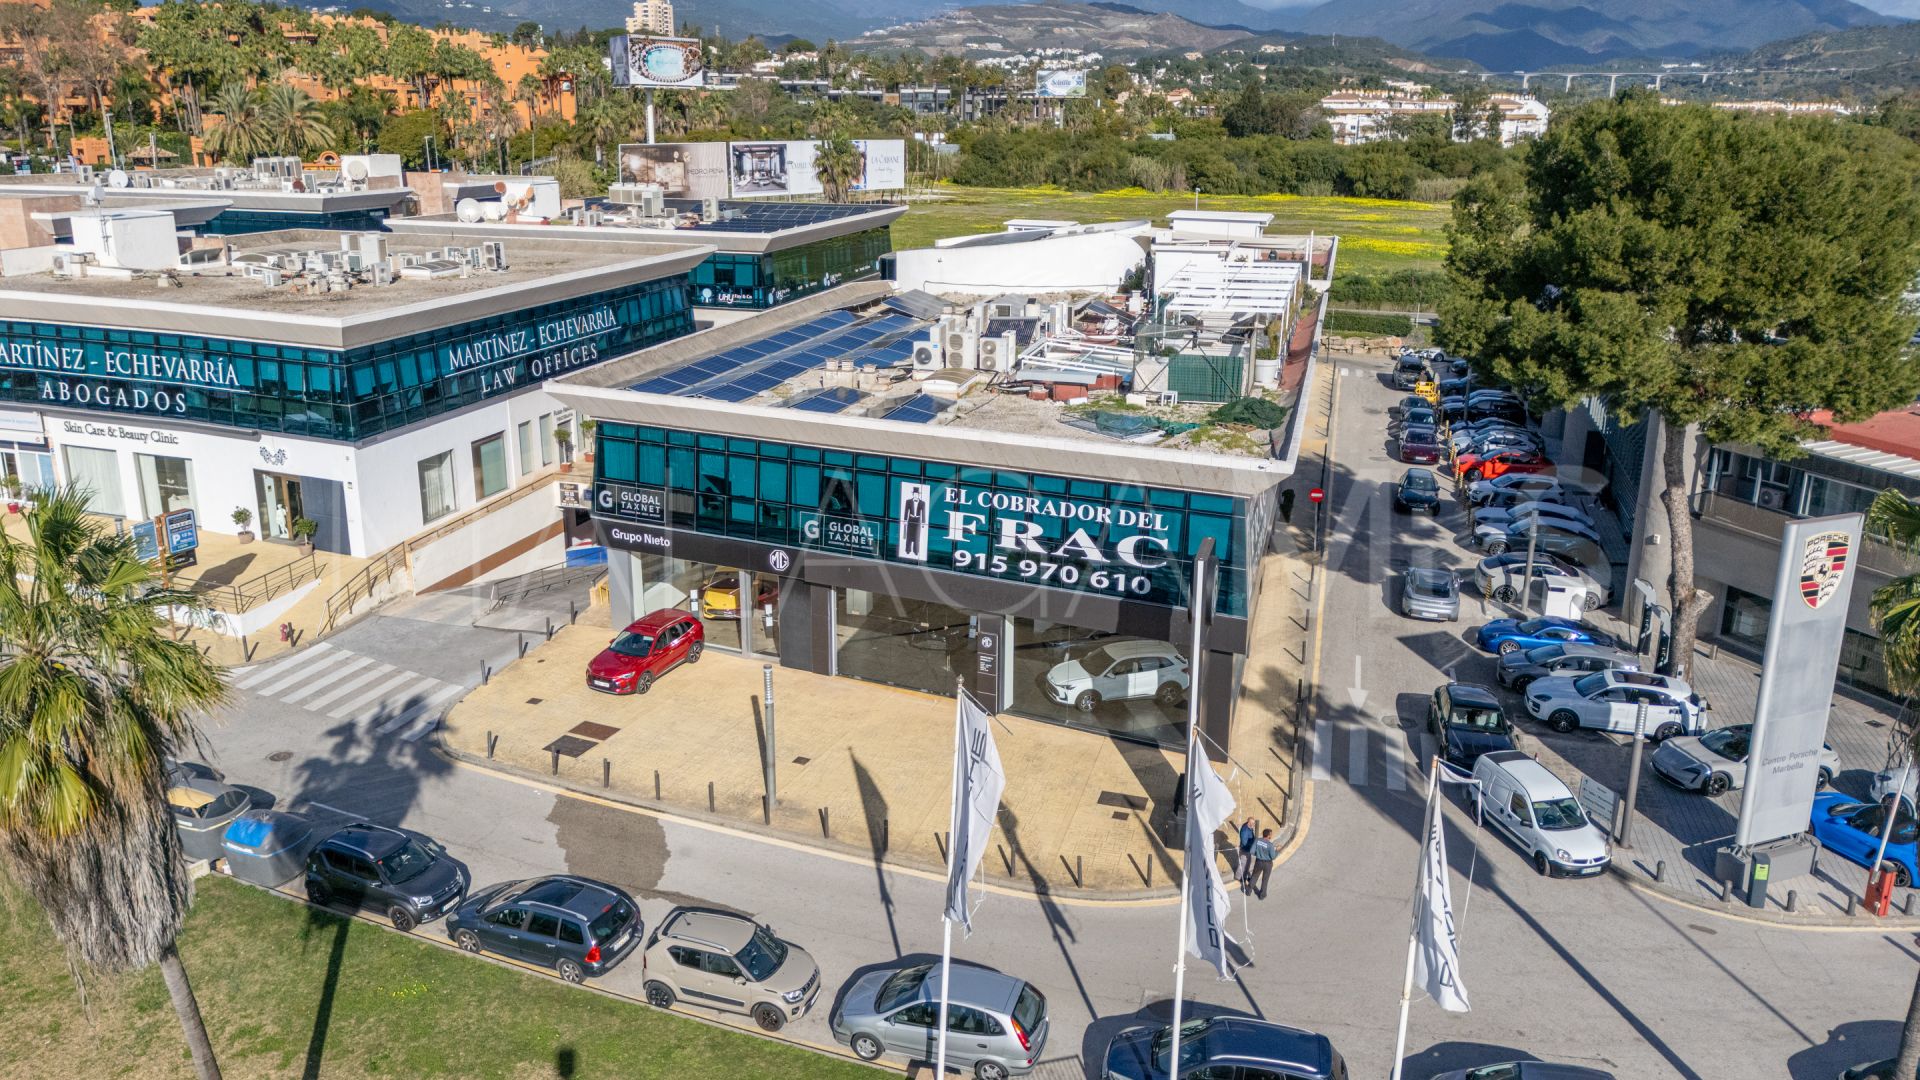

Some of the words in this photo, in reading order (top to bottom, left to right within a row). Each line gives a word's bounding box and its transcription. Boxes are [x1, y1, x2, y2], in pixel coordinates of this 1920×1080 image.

[449, 331, 528, 370] MARTÍNEZ
[539, 306, 617, 345] ECHEVARRÍA
[0, 340, 86, 371] ARTÍNEZ
[104, 350, 240, 386] ECHEVARRÍA
[480, 366, 517, 393] LAW
[41, 381, 186, 412] ABOGADOS
[63, 420, 83, 433] Skin
[84, 423, 106, 437] Care
[107, 426, 117, 438] &
[118, 427, 149, 444] Beauty
[150, 430, 179, 445] Clinic
[599, 490, 613, 508] G
[621, 491, 661, 505] GLOBAL
[621, 501, 661, 514] TAXNET
[944, 486, 973, 506] EL
[977, 491, 1112, 524] COBRADOR
[1117, 509, 1169, 532] DEL
[612, 528, 642, 543] Grupo
[643, 533, 671, 546] Nieto
[804, 520, 820, 539] G
[828, 531, 874, 546] TAXNET
[829, 522, 874, 537] GLOBAL
[942, 510, 1169, 569] FRAC
[1807, 535, 1850, 548] PORSCHE
[770, 550, 790, 571] MG
[953, 550, 1008, 574] 915
[1019, 560, 1079, 584] 970
[1090, 571, 1152, 595] 610
[1762, 756, 1787, 766] Centro
[1789, 749, 1818, 760] Porsche
[1772, 762, 1804, 774] Marbella
